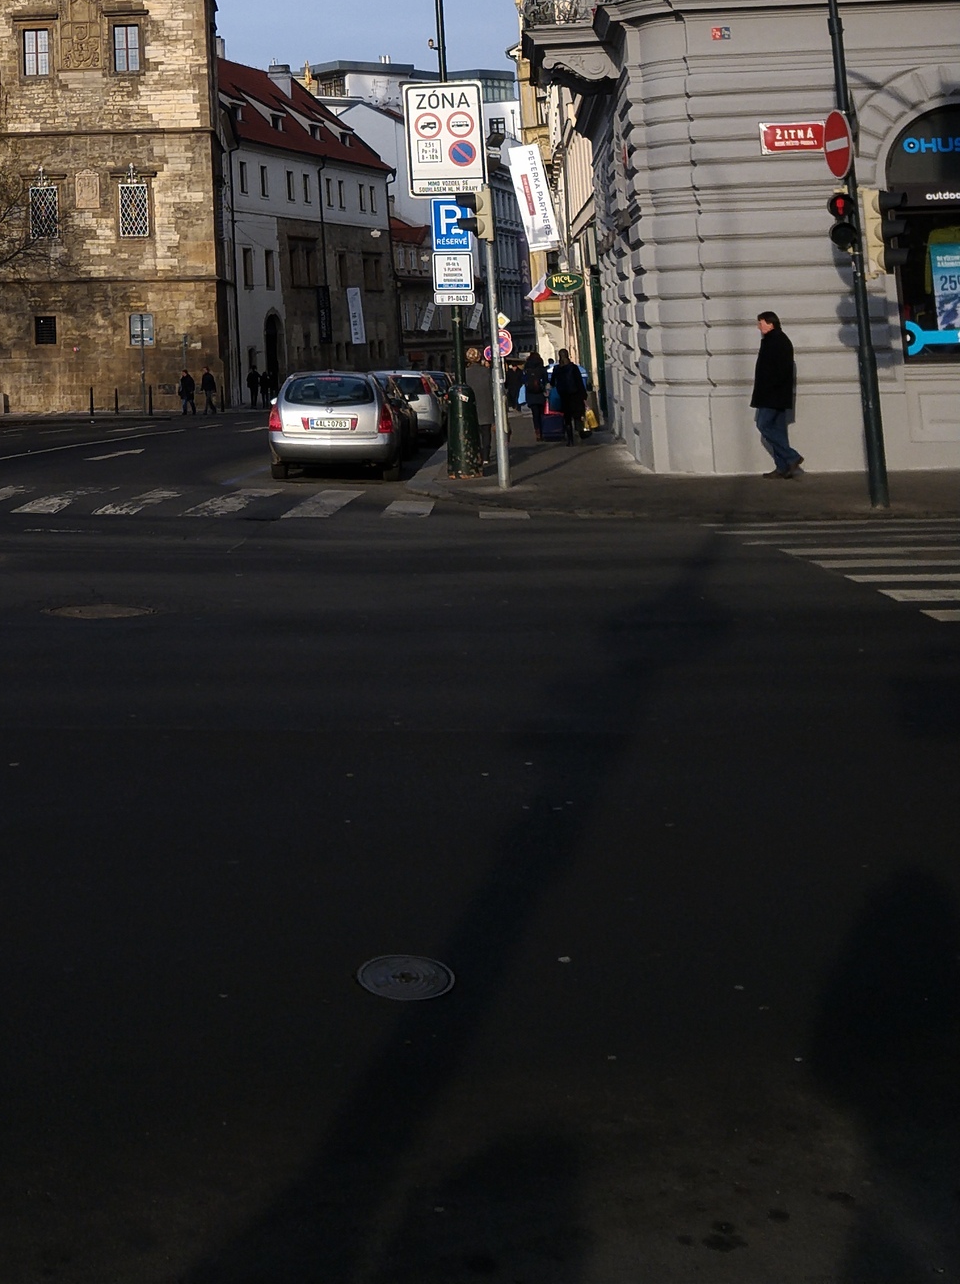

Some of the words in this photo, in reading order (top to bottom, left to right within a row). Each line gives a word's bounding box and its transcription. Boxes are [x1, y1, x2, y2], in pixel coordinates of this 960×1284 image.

[415, 90, 470, 110] ZÓNA
[775, 127, 815, 140] ŽITNÁ
[527, 150, 541, 190] PETERKA
[537, 191, 553, 236] PARTNERS
[440, 205, 462, 235] P
[436, 237, 468, 245] RÉSERVÉ
[521, 259, 529, 284] AXA
[552, 275, 573, 288] NICOL
